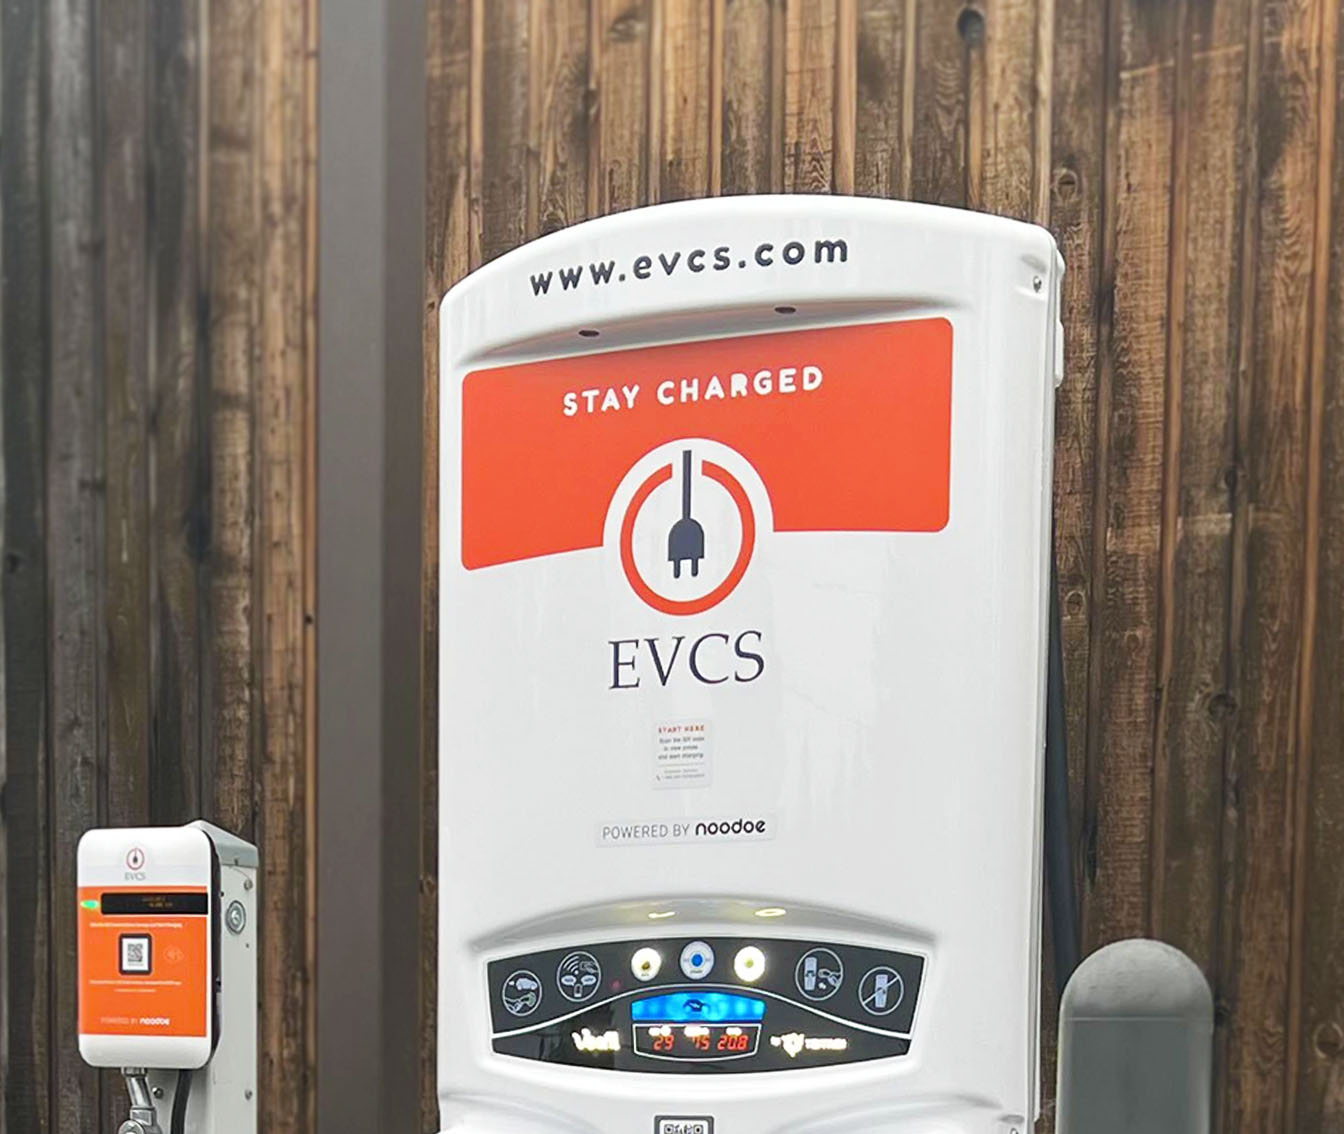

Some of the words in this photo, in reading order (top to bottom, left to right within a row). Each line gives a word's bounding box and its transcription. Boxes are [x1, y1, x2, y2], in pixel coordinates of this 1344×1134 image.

[529, 236, 849, 297] www.evcs.com
[561, 384, 640, 417] STAY
[656, 366, 824, 405] CHARGED
[608, 630, 765, 689] EVCS
[602, 824, 668, 840] POWERED
[673, 823, 690, 838] BY
[695, 818, 766, 836] noodoe
